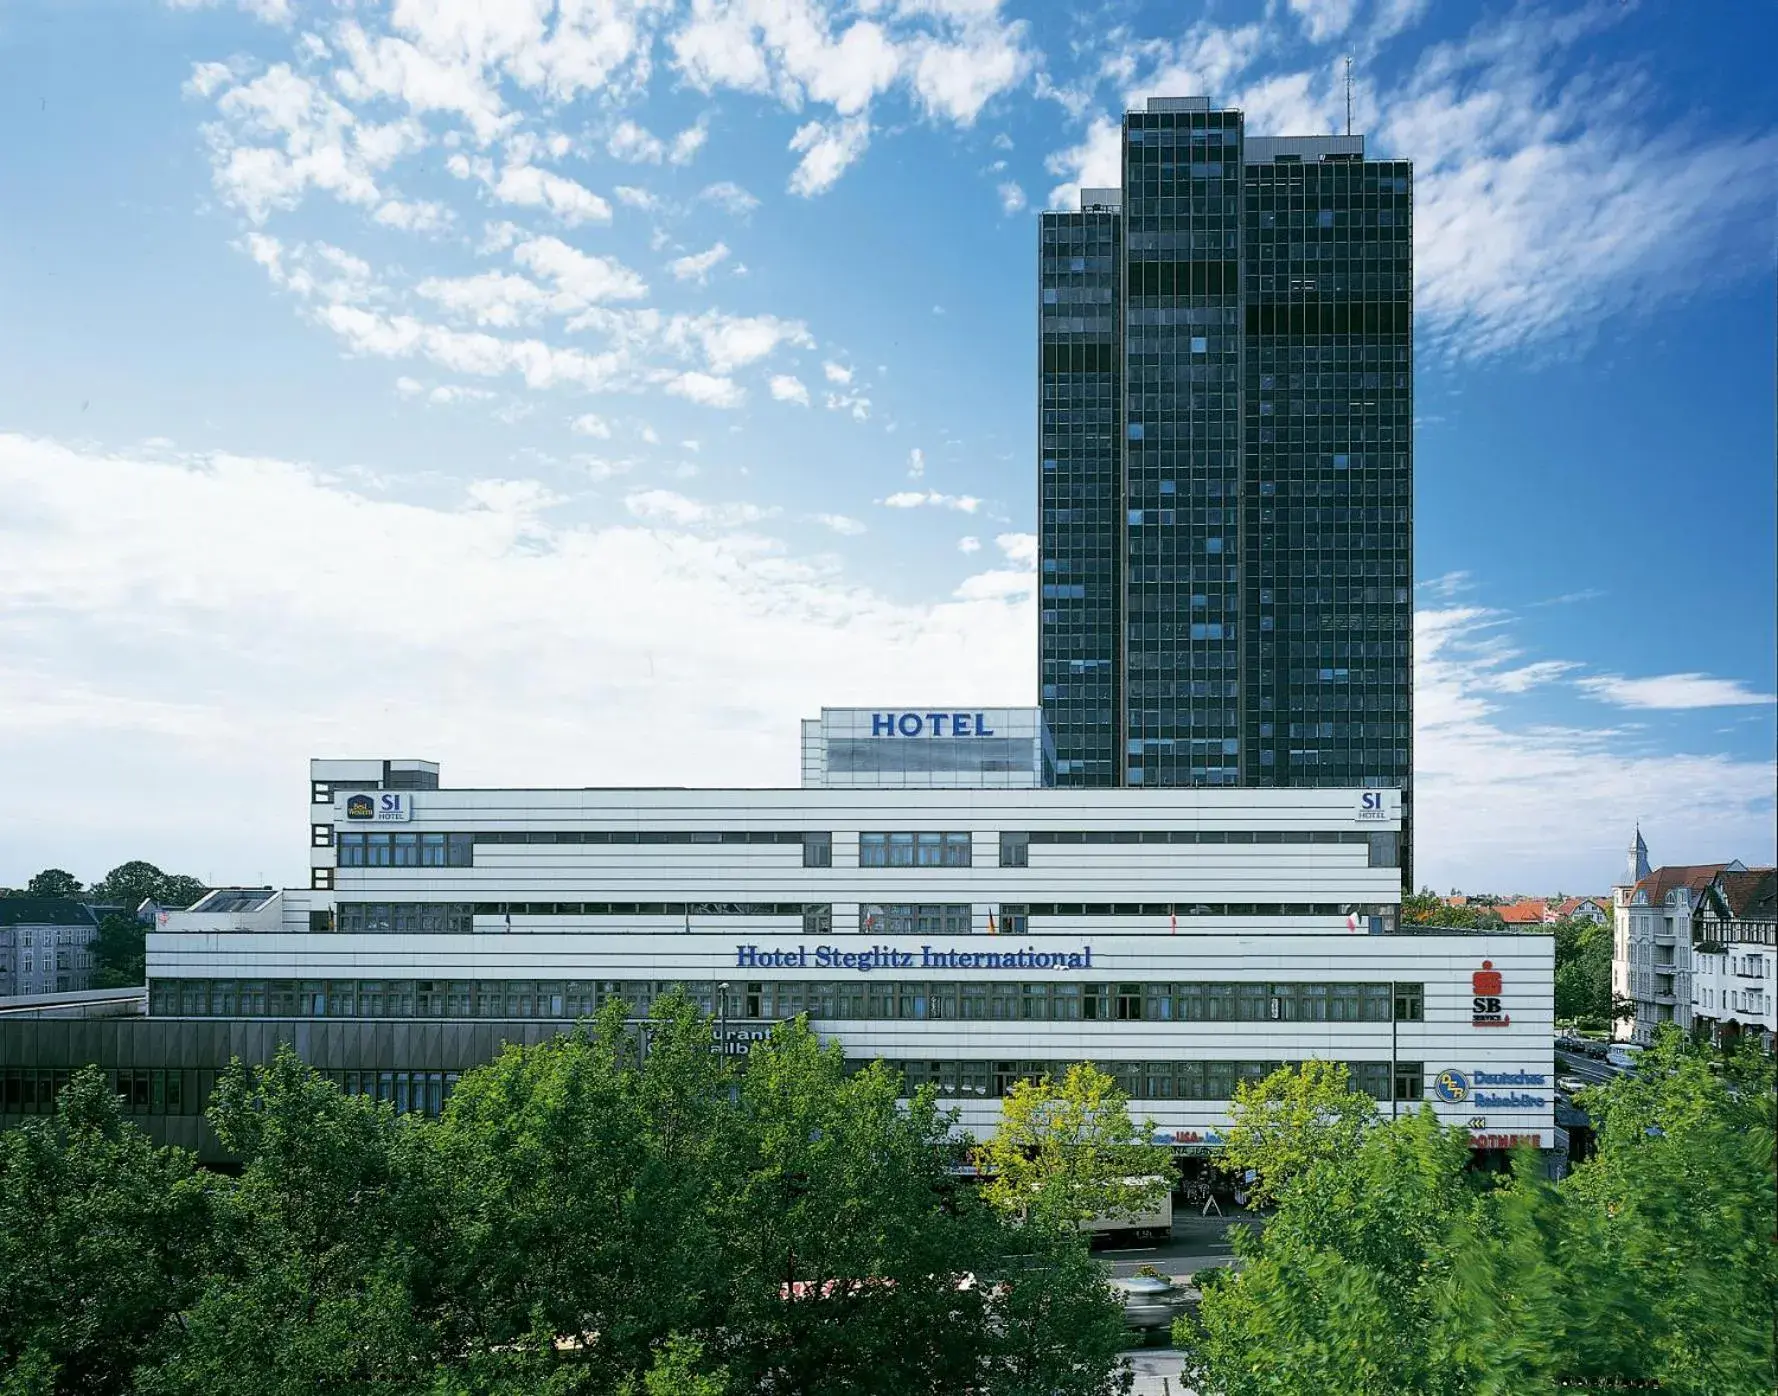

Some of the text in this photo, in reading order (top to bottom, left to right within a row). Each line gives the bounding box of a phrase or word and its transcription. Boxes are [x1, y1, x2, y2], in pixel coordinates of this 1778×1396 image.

[872, 713, 994, 737] HOTEL
[381, 794, 400, 811] SI
[1362, 792, 1382, 809] SI
[736, 945, 1092, 972] Hotel Steglitz International
[1472, 997, 1502, 1013] SB
